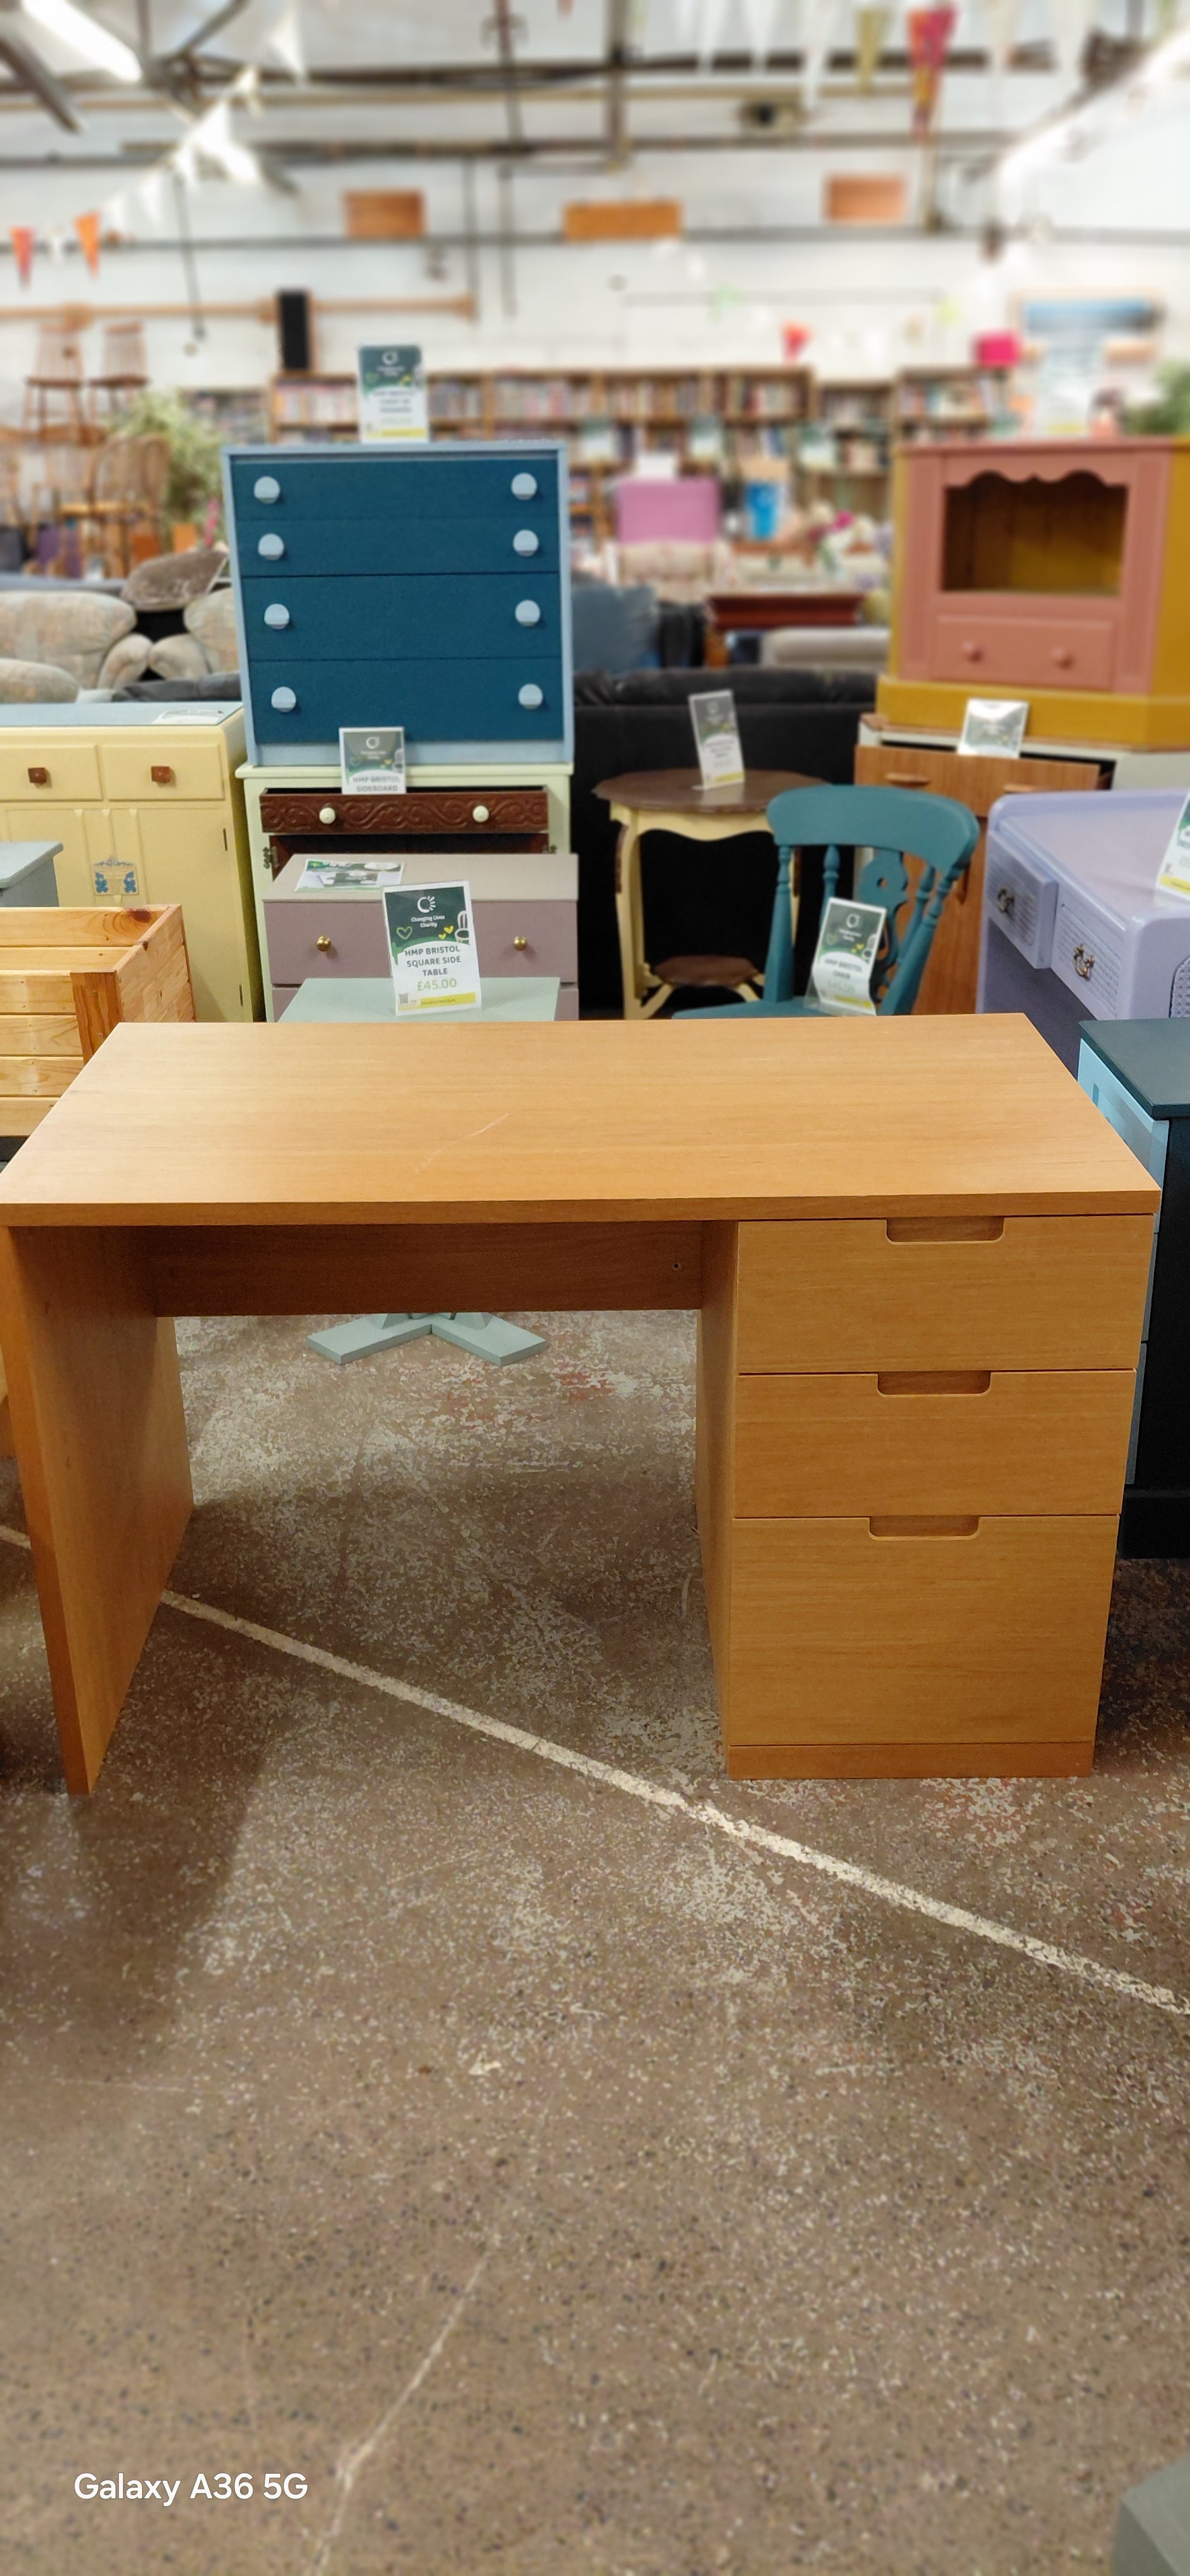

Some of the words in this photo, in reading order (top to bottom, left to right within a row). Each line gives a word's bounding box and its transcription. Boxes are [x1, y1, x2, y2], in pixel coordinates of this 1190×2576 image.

[405, 948, 424, 957] HMP
[426, 945, 460, 955] BRISTOL
[406, 958, 440, 968] SQUARE
[443, 956, 461, 964] SIDE
[423, 968, 448, 977] TABLE
[417, 978, 457, 991] £45.00
